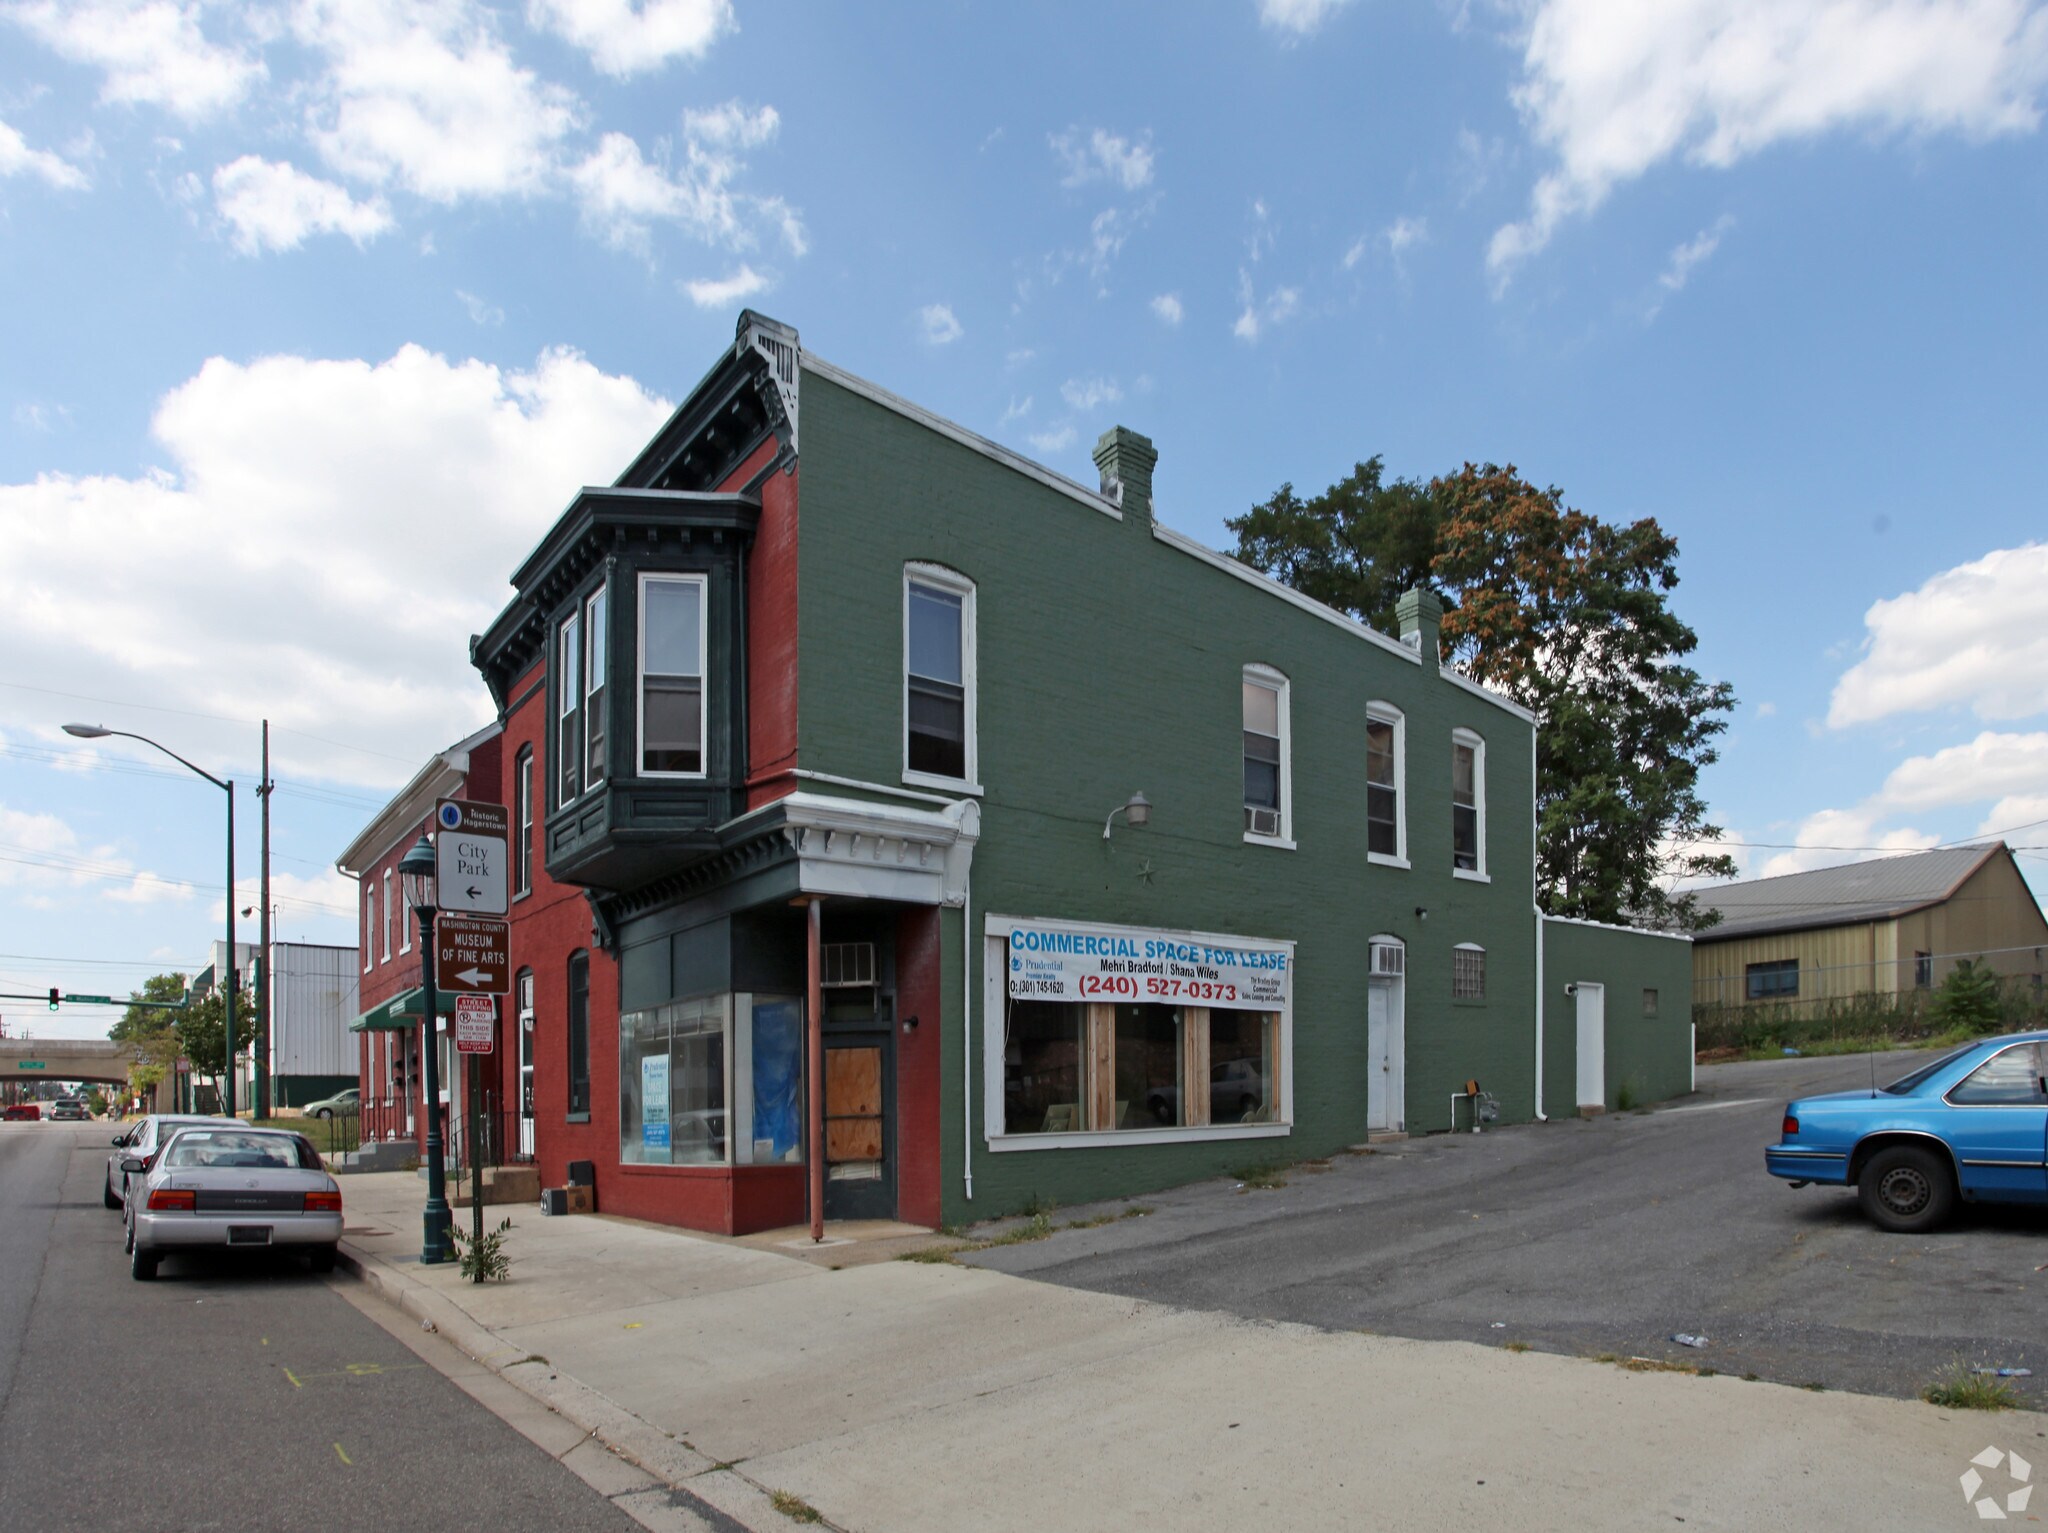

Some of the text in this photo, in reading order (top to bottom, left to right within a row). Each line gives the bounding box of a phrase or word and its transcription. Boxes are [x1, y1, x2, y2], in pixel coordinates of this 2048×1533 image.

[470, 809, 499, 821] Historic
[463, 818, 507, 830] Hagerstown
[458, 842, 488, 861] City
[458, 860, 489, 876] Park
[441, 920, 505, 932] WASHINGTON COUNTY
[454, 933, 493, 948] MUSEUM
[442, 948, 505, 965] OF FINE ARTS
[1010, 930, 1286, 970] COMMERCIAL SPACE FOR LEASE
[1025, 959, 1063, 971] Prudential
[1100, 958, 1126, 972] Mehri
[1127, 960, 1164, 975] Bradford
[1171, 963, 1195, 978] Shana
[1196, 966, 1219, 980] Wiles
[1010, 980, 1064, 996] O: (301) 745-1620
[1079, 975, 1236, 1001] (240) 527-0373
[1253, 985, 1278, 994] Commercial
